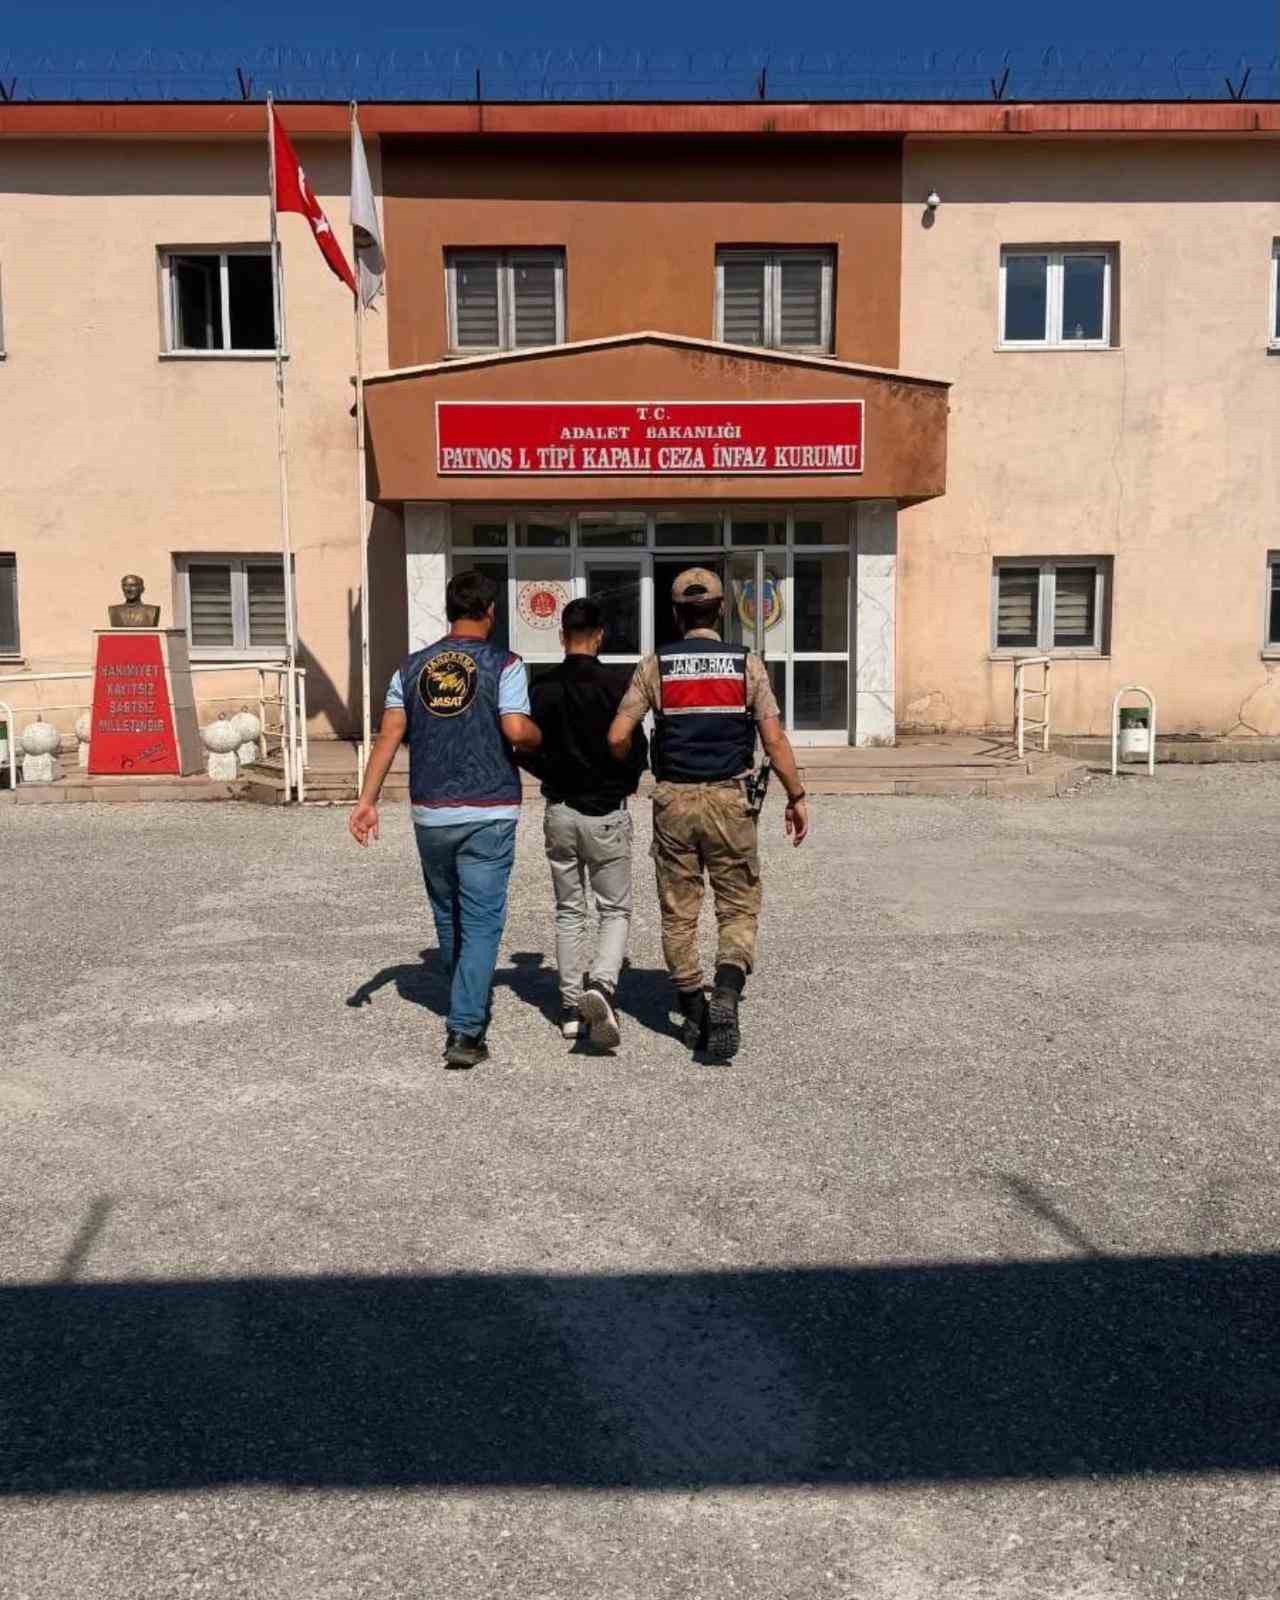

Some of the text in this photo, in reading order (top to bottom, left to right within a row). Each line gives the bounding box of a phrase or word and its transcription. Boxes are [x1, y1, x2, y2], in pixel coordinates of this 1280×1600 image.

[636, 407, 671, 421] T.C.
[560, 422, 742, 440] ADALET BAKANLIĞI
[441, 447, 513, 470] PATNOS
[536, 444, 576, 469] TİPİ
[582, 447, 652, 470] KAPALI
[657, 446, 706, 470] CEZA
[711, 443, 767, 469] İNFAZ
[774, 445, 859, 468] KURUMU
[668, 657, 736, 675] JANDARMA
[430, 696, 465, 708] JASAT
